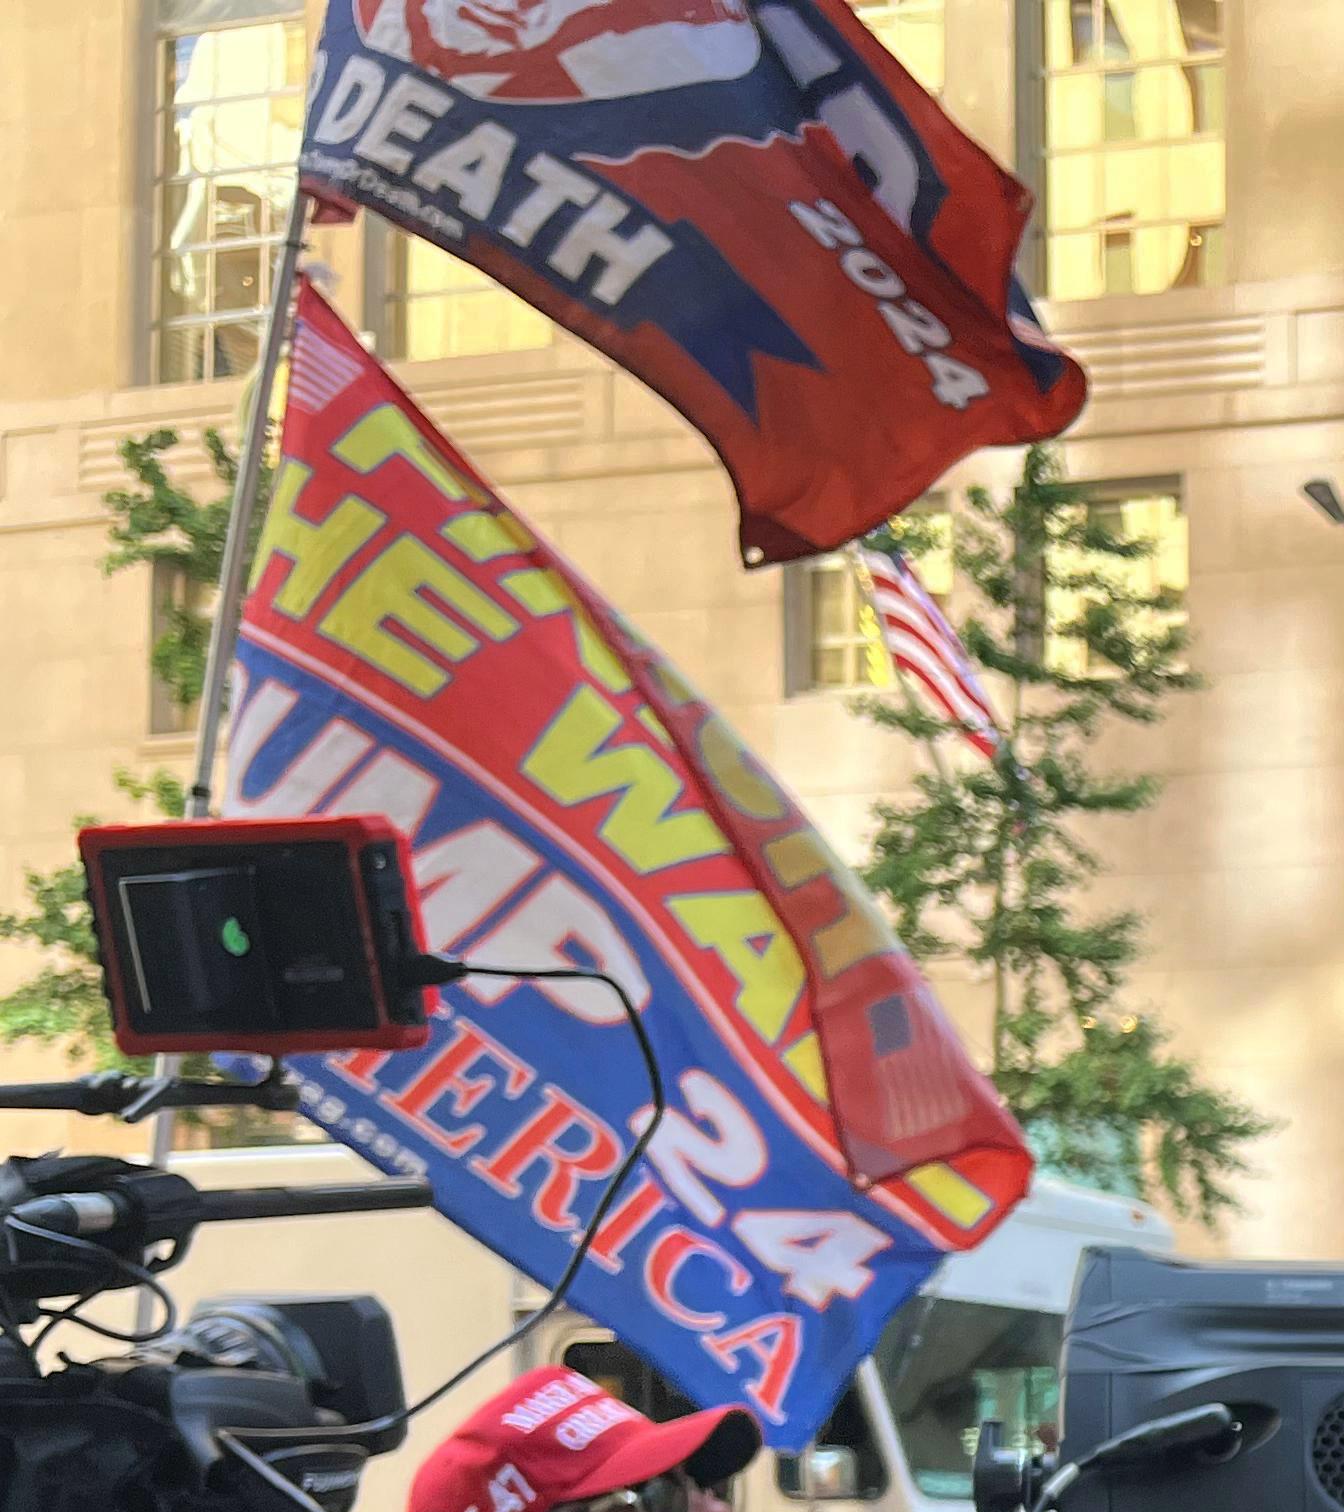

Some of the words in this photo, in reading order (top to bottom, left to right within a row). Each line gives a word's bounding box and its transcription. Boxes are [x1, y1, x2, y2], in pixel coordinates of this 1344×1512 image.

[313, 54, 674, 306] DEATH
[787, 198, 990, 410] 2024
[230, 660, 651, 1025] UMP
[630, 1068, 894, 1312] 24
